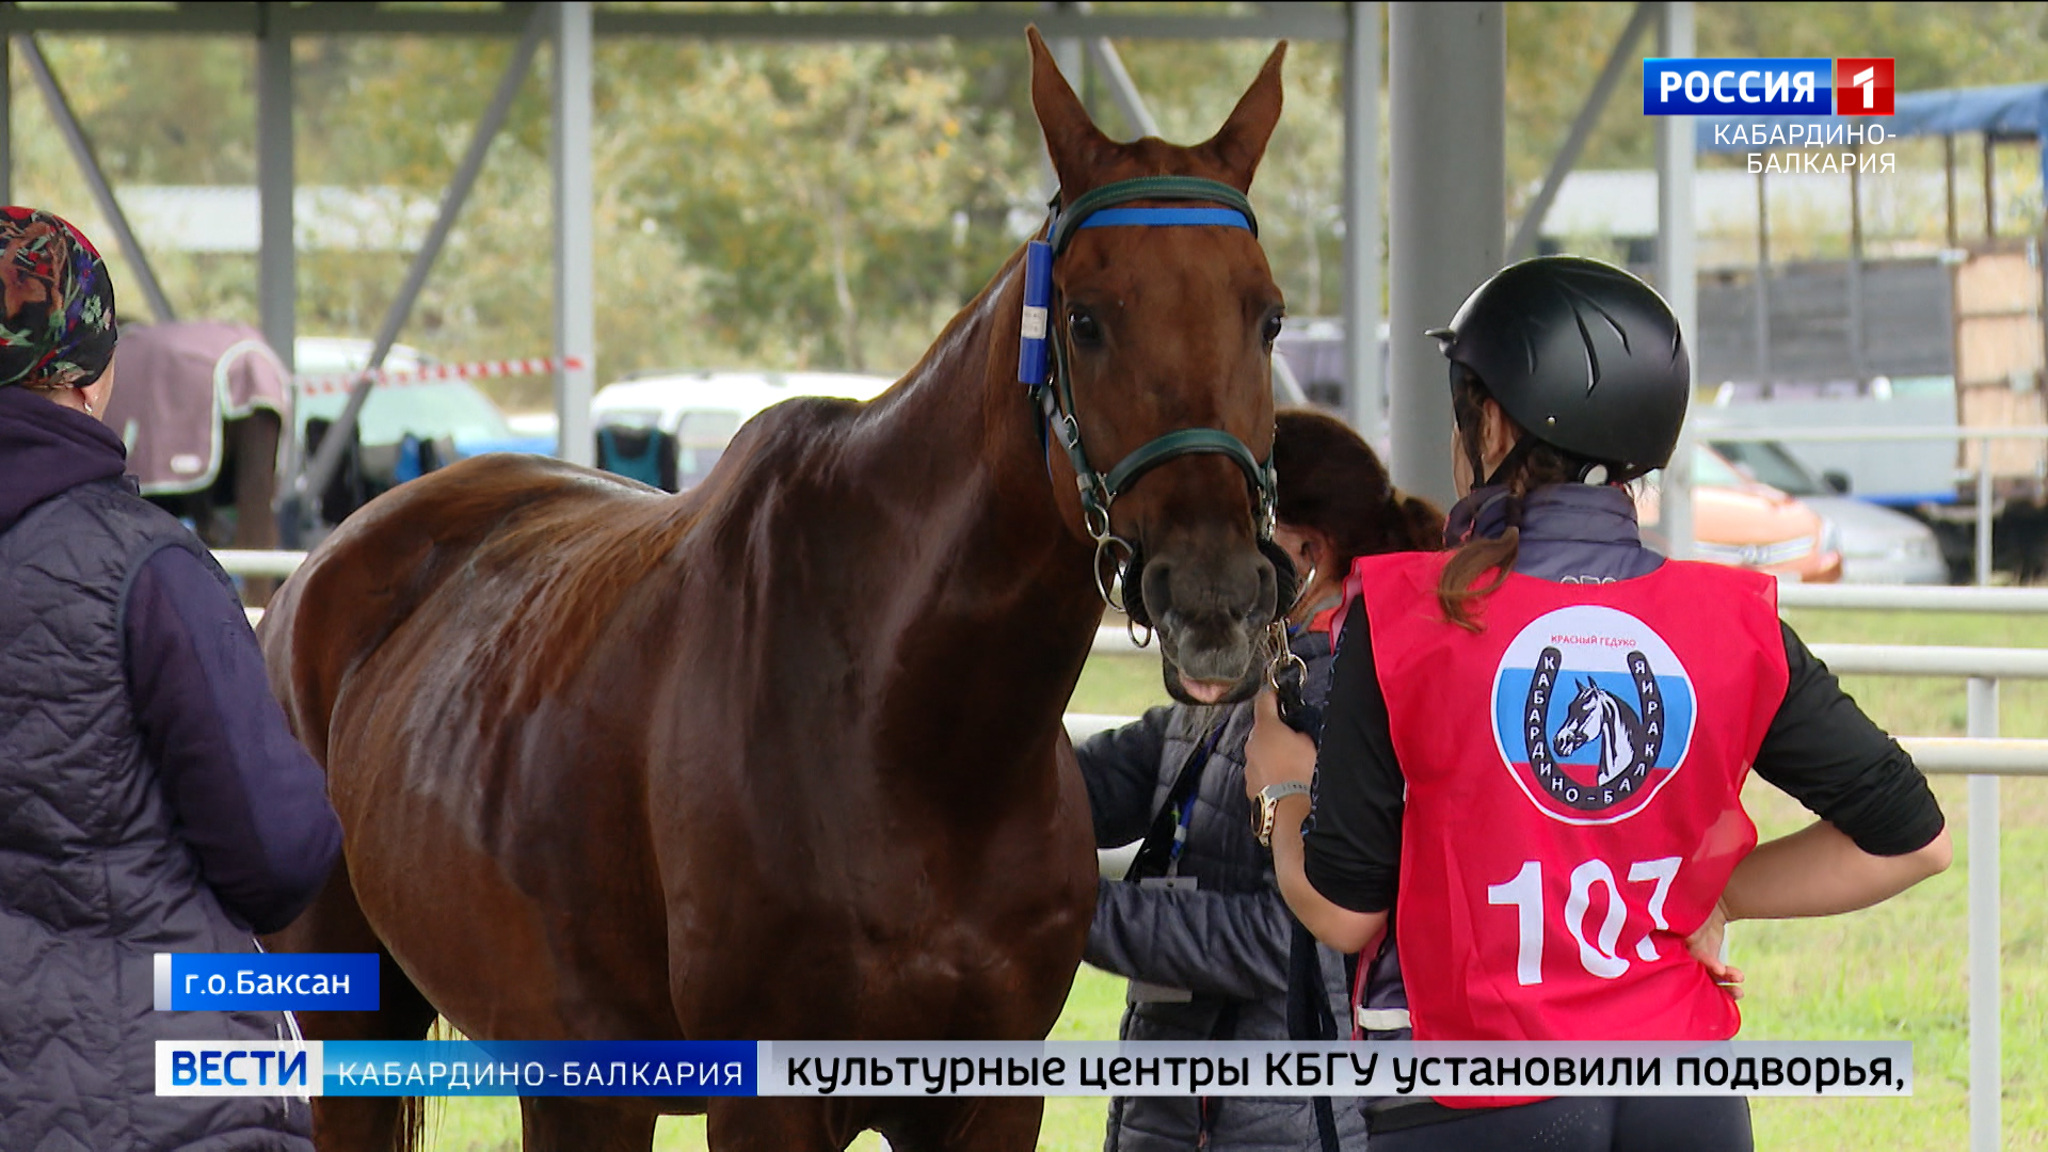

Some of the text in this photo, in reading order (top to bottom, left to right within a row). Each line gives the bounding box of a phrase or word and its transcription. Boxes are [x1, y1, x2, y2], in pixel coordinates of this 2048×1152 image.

[1551, 635, 1637, 648] КРАСНЫЙ ГЕДУКО
[1488, 856, 1683, 985] 107
